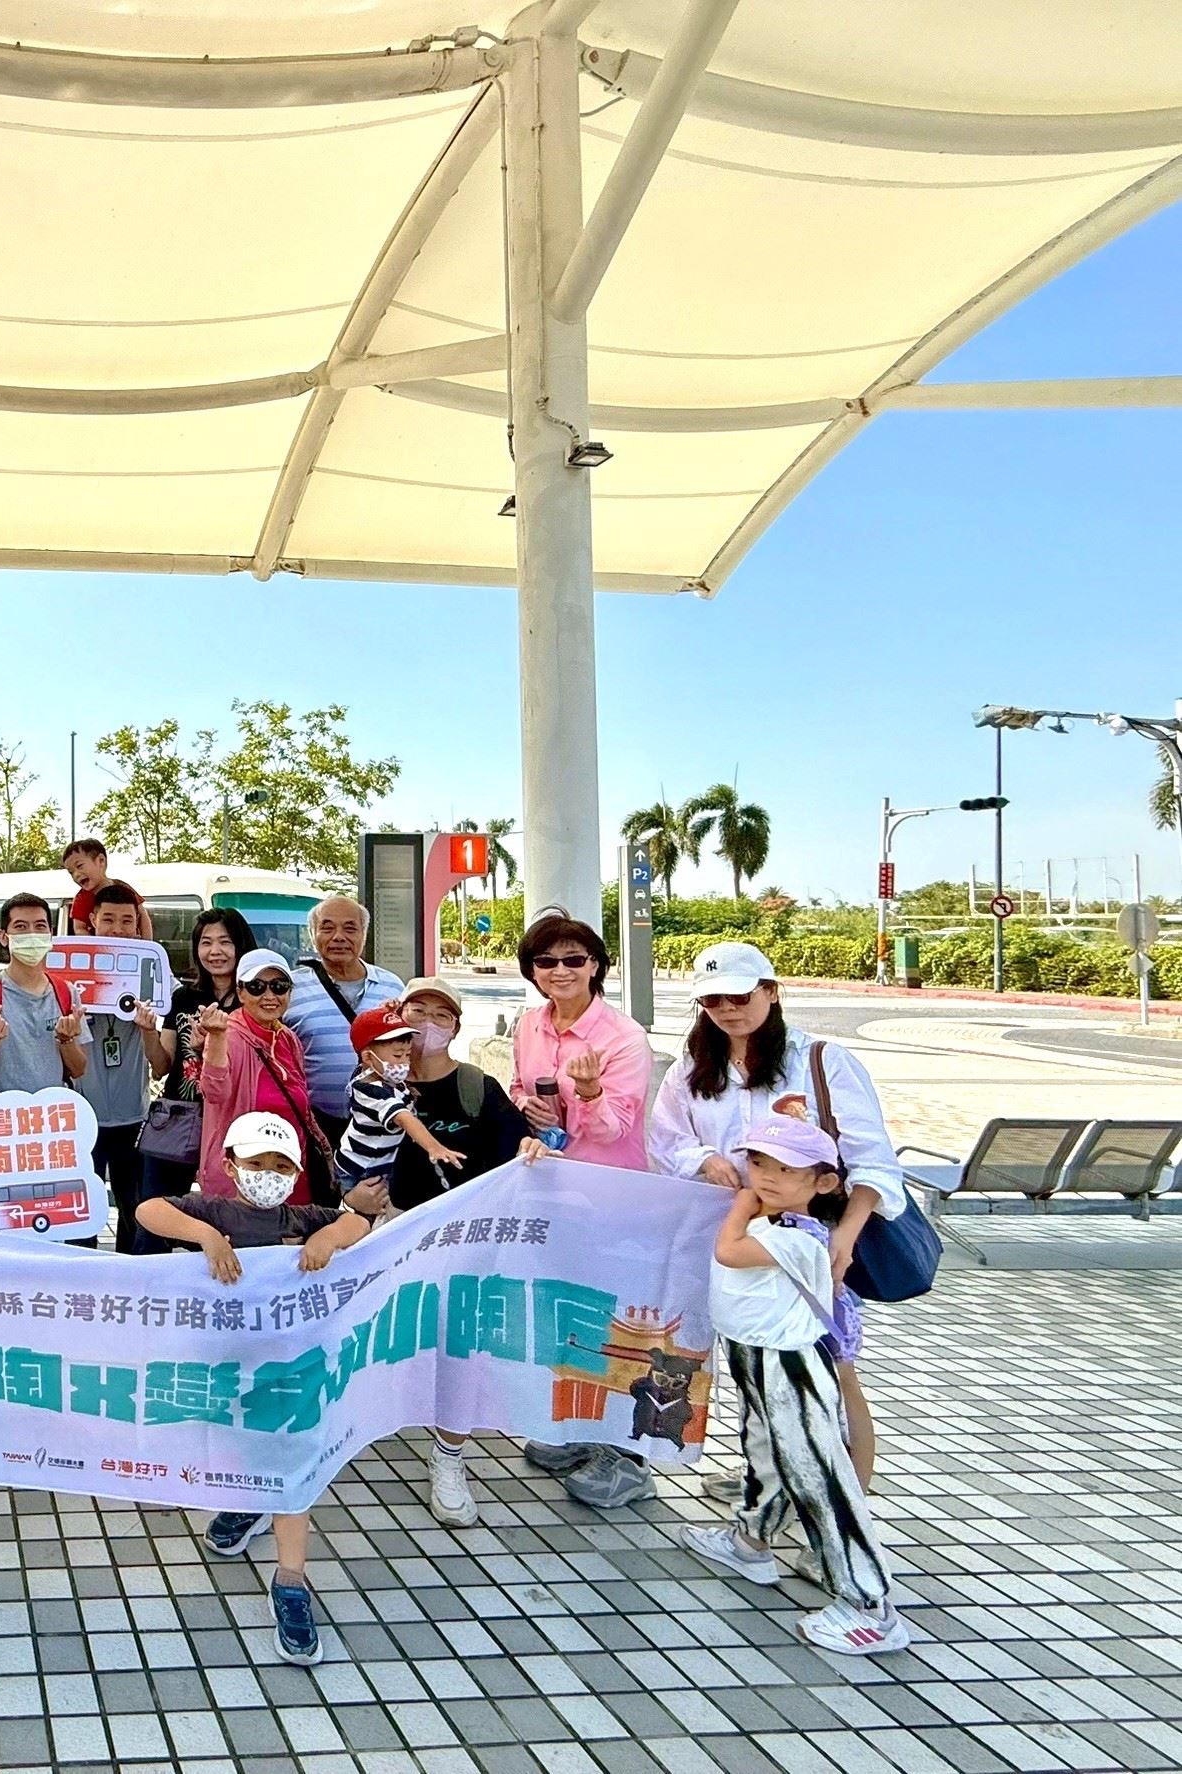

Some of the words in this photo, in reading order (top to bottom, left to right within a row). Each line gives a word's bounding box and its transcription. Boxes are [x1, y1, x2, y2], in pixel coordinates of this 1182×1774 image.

[462, 839, 474, 871] 1
[632, 867, 649, 881] P2
[101, 1458, 168, 1477] 台灣好行
